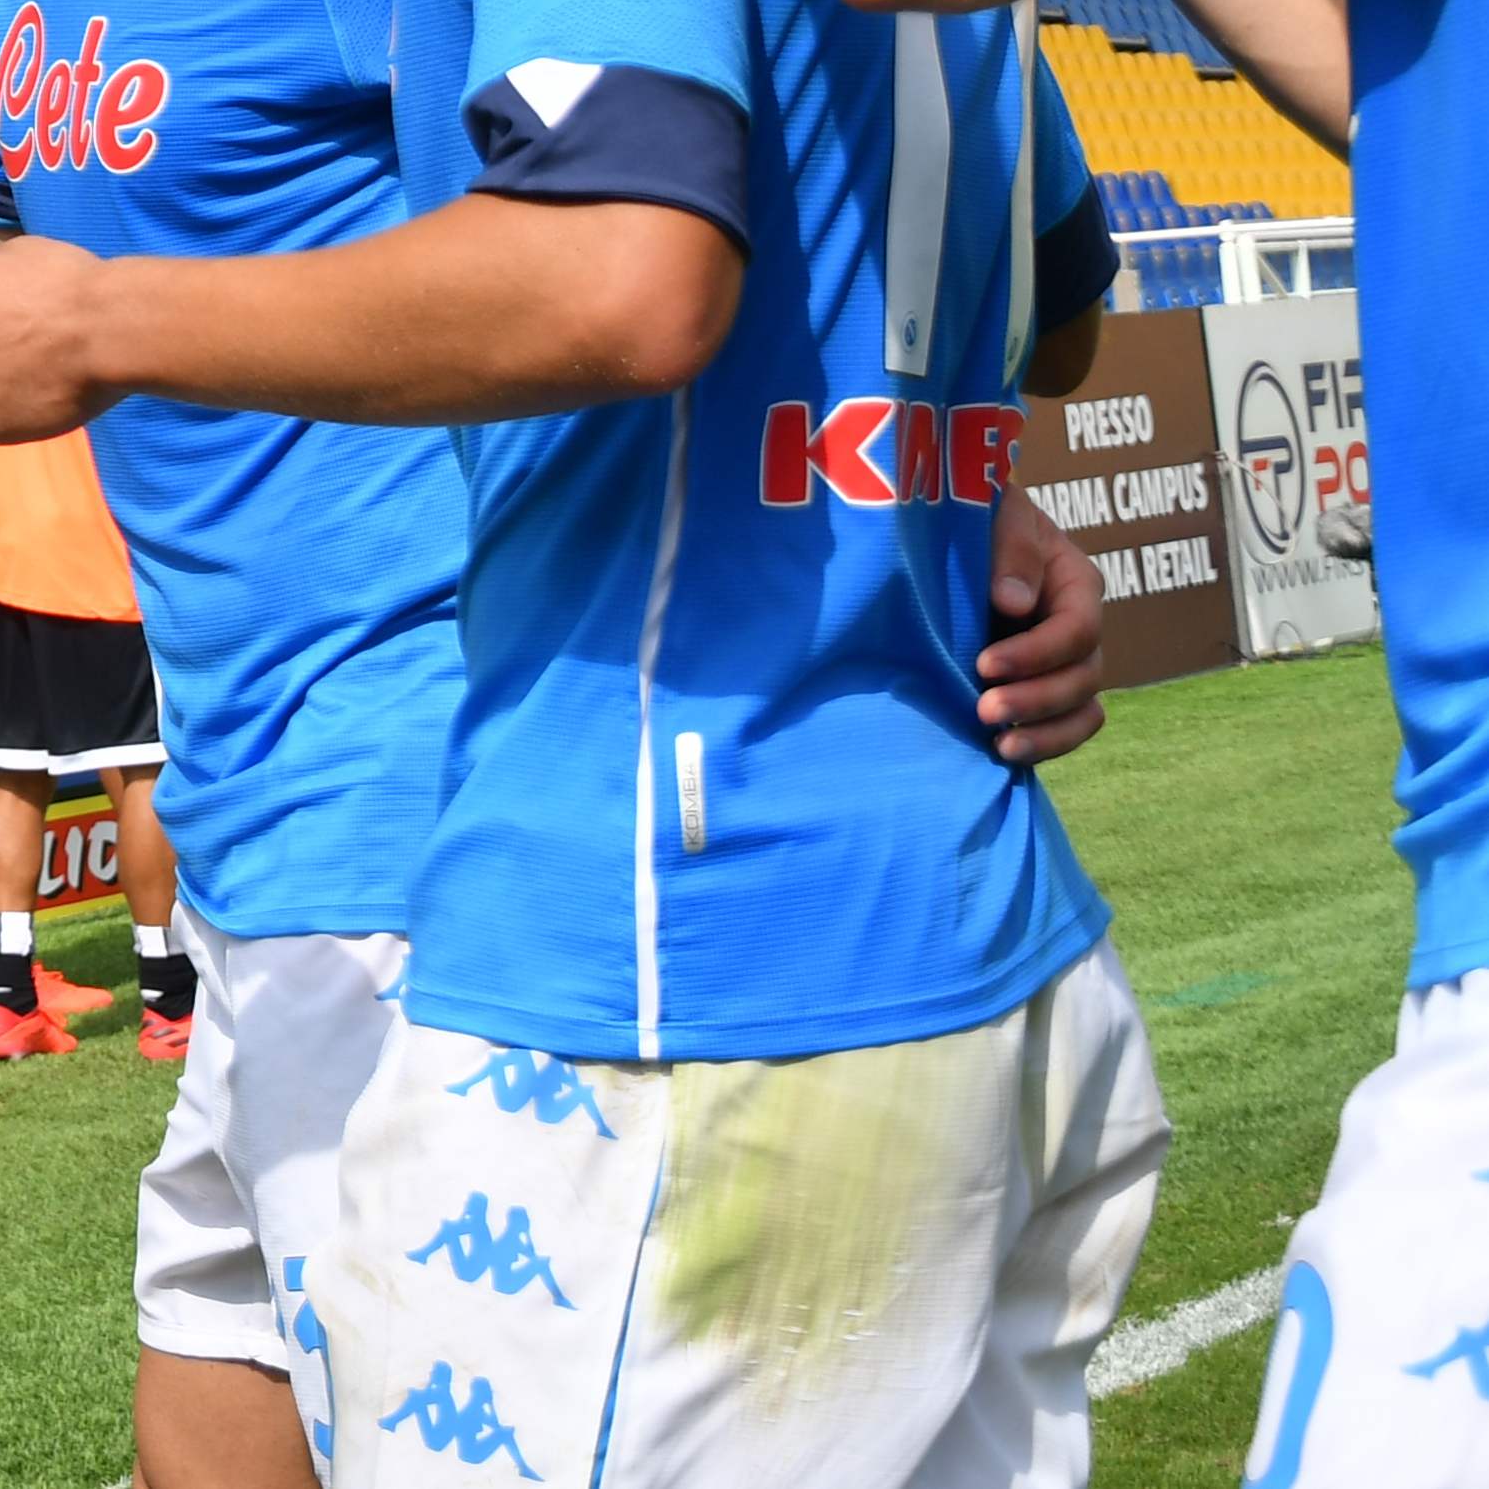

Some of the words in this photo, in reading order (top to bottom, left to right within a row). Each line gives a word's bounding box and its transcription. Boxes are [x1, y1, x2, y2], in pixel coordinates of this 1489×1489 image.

[1064, 394, 1154, 453] PRESSO
[1113, 461, 1209, 523] CAMPUS
[1140, 535, 1218, 594] RETAIL
